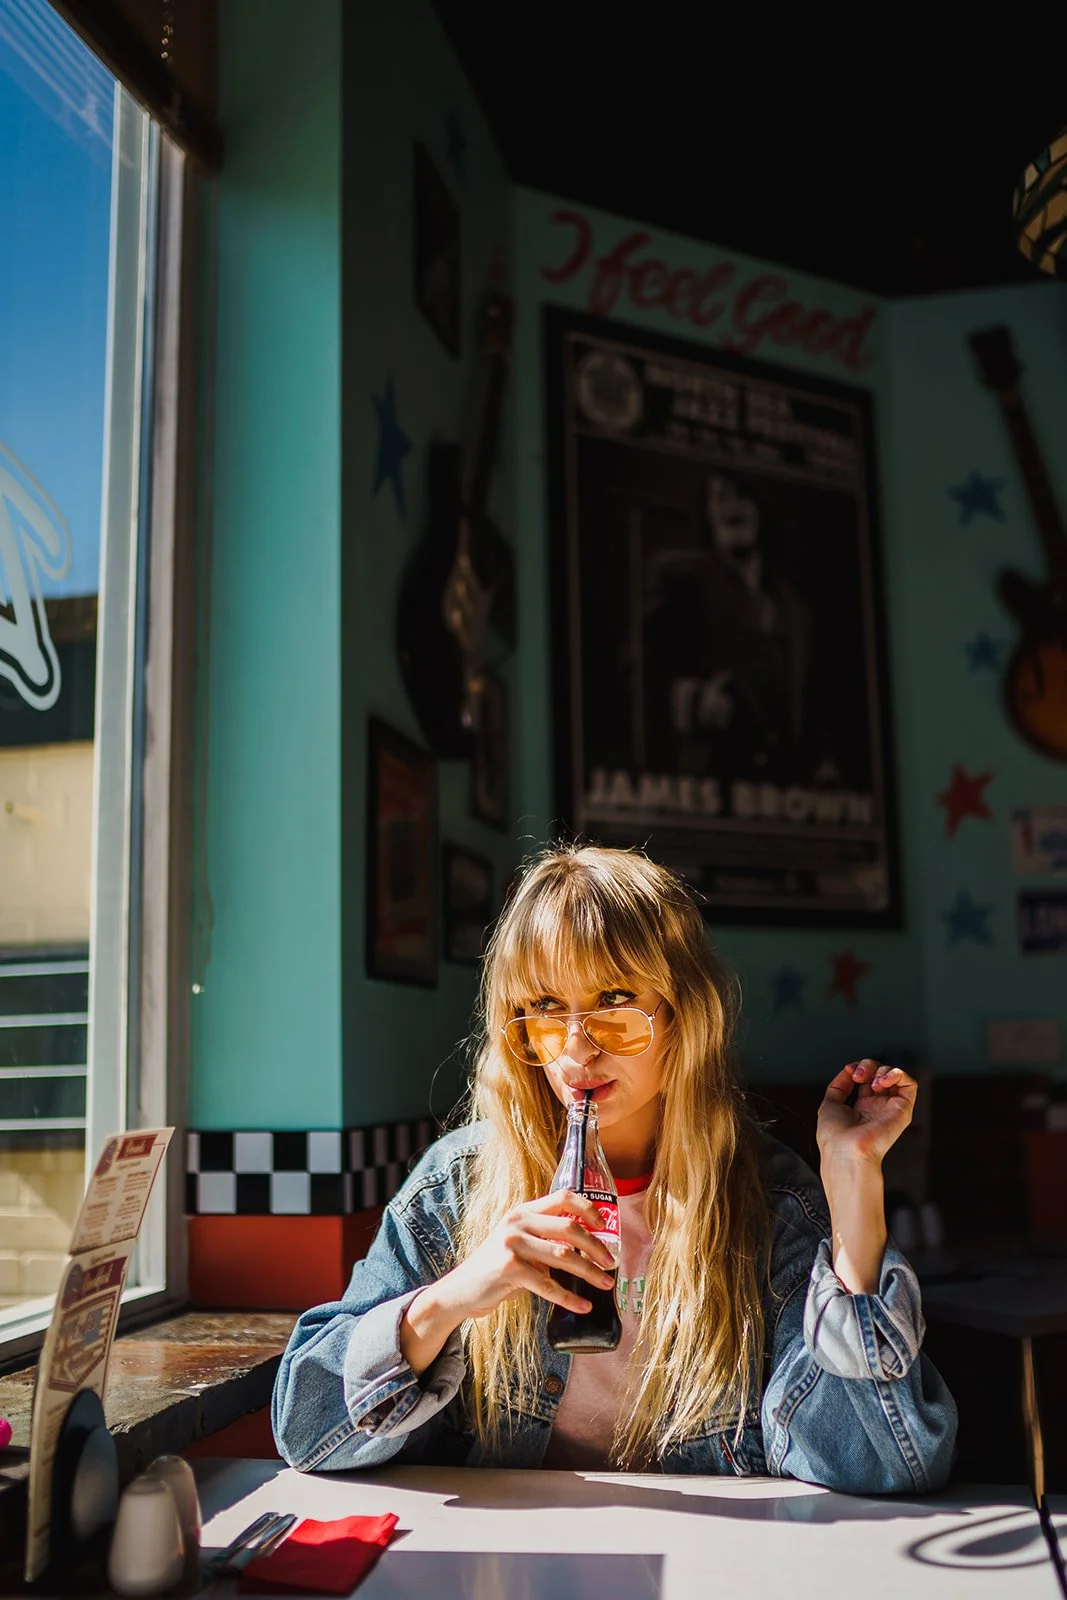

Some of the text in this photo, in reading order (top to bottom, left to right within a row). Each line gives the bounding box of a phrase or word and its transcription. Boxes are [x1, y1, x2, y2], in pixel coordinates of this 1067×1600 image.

[589, 233, 735, 325] feel
[721, 275, 876, 369] Good
[588, 767, 872, 826] JAMES BROWN
[590, 1193, 613, 1202] SUGAR
